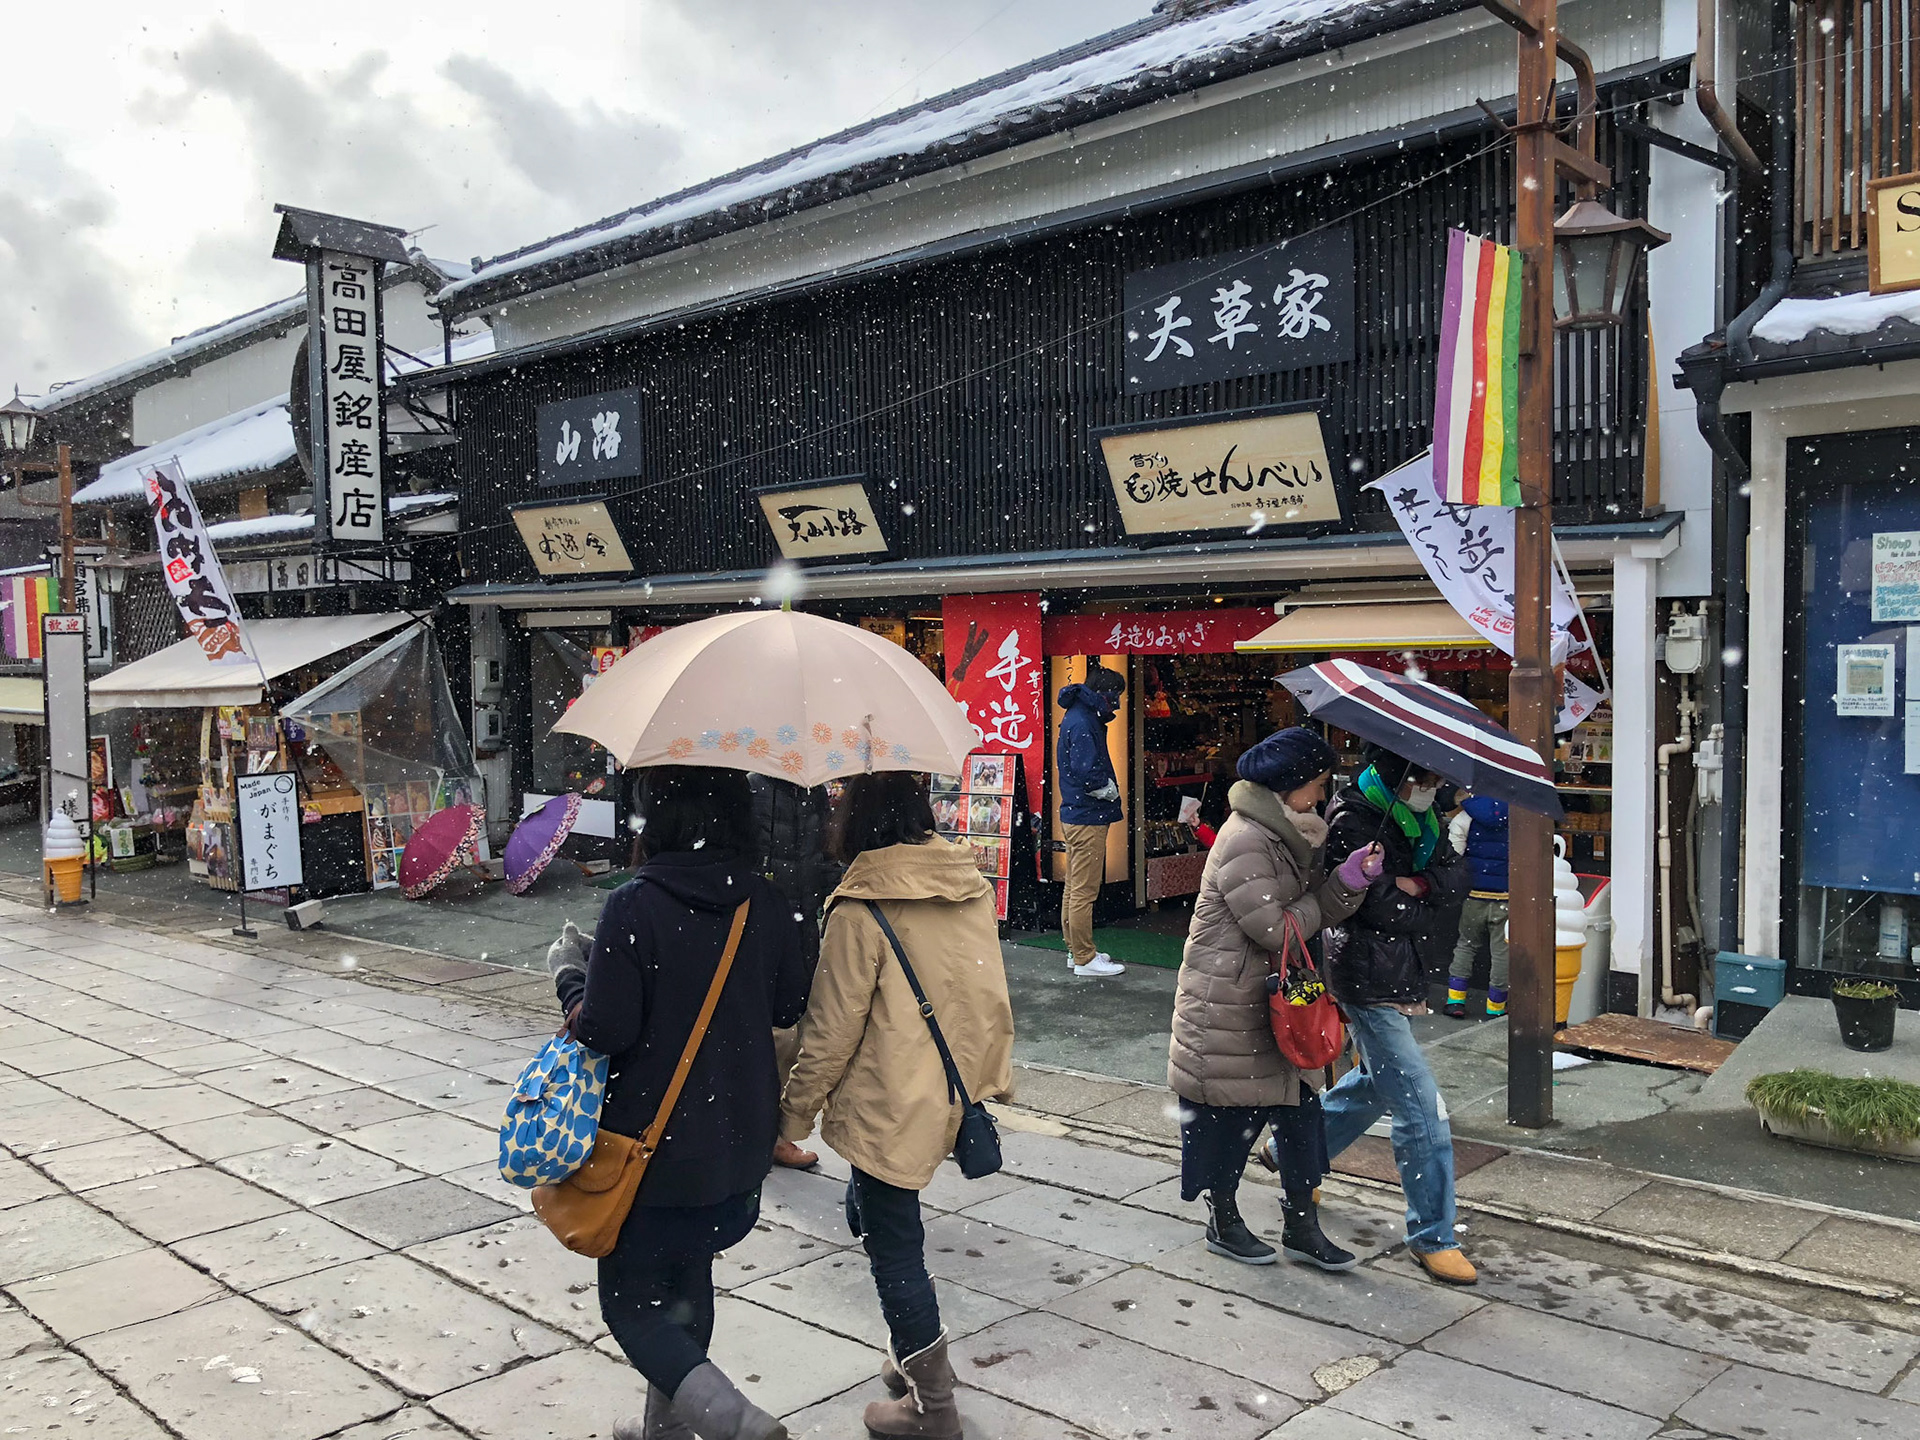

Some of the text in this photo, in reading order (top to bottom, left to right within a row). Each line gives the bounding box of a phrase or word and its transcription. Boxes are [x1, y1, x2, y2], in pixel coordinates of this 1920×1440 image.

[1143, 268, 1331, 362] 天草家
[329, 262, 376, 528] 高田屋銘産店
[1124, 444, 1322, 504] もち焼せんべい
[48, 619, 80, 632] 歓迎
[240, 779, 261, 790] Made
[249, 786, 272, 799] Japan
[281, 797, 290, 822] 手作り
[260, 802, 278, 880] がまぐち
[250, 858, 259, 885] 専門店
